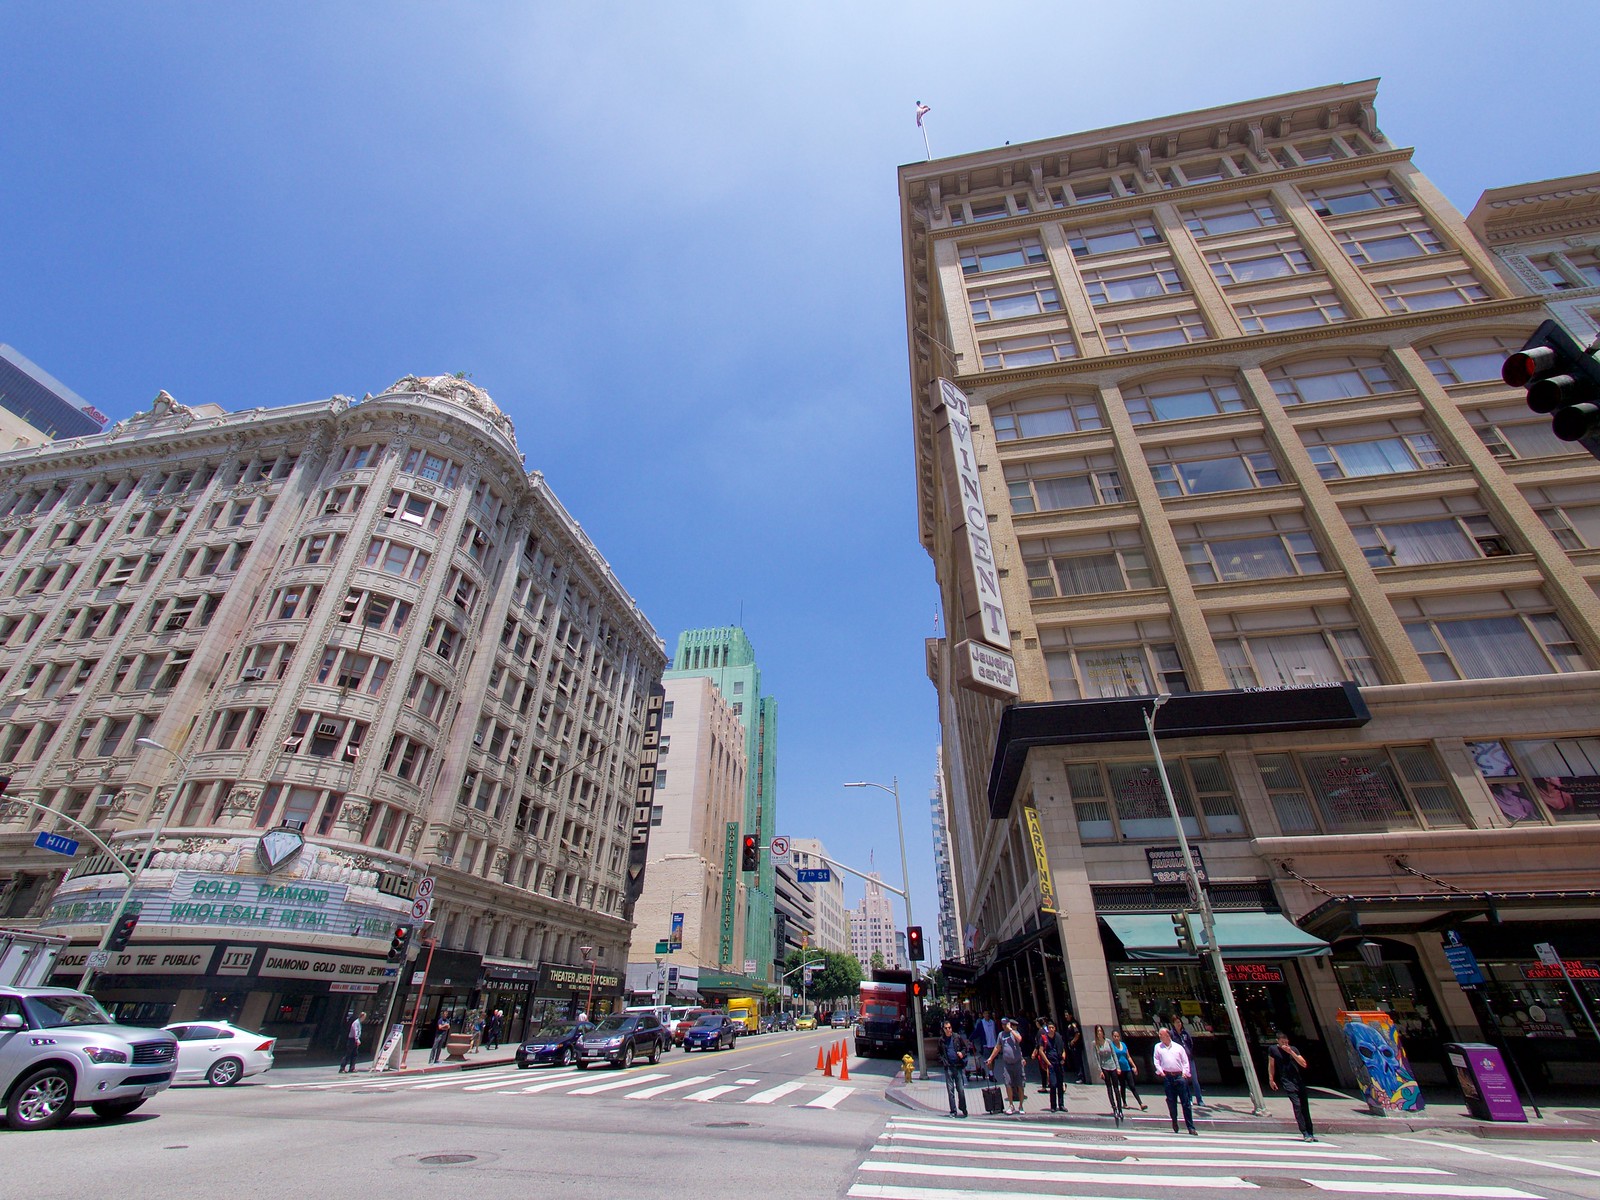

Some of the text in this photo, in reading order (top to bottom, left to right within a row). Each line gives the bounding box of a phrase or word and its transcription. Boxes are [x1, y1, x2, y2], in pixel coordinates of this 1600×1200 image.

[951, 418, 1002, 636] VINCENT
[1326, 767, 1371, 777] SILVER
[1128, 779, 1160, 787] SILVE
[1028, 811, 1050, 895] PARKING
[1175, 849, 1199, 858] SPCE
[1151, 857, 1202, 869] AVAILALE
[801, 871, 828, 881] 7th St
[193, 880, 330, 903] GOLD DIAMOND
[722, 824, 736, 963] WHOLESALE JEWELRY MART
[92, 901, 143, 917] CENER
[170, 902, 329, 926] WHOLESALE RETAIL
[117, 954, 132, 966] TO
[136, 954, 157, 966] THE
[162, 954, 201, 966] PUBLIC
[222, 952, 252, 966] JTB
[266, 957, 309, 971] DIAMOND
[313, 962, 336, 973] GOLD
[339, 964, 366, 976] SILVER
[1235, 964, 1266, 973] VINCENT
[550, 969, 618, 987] THEATER JEWELRY CENTER
[1251, 972, 1280, 980] CENTER
[1527, 968, 1600, 978] JEWELRY CENTER
[486, 980, 529, 992] ENTRANCE
